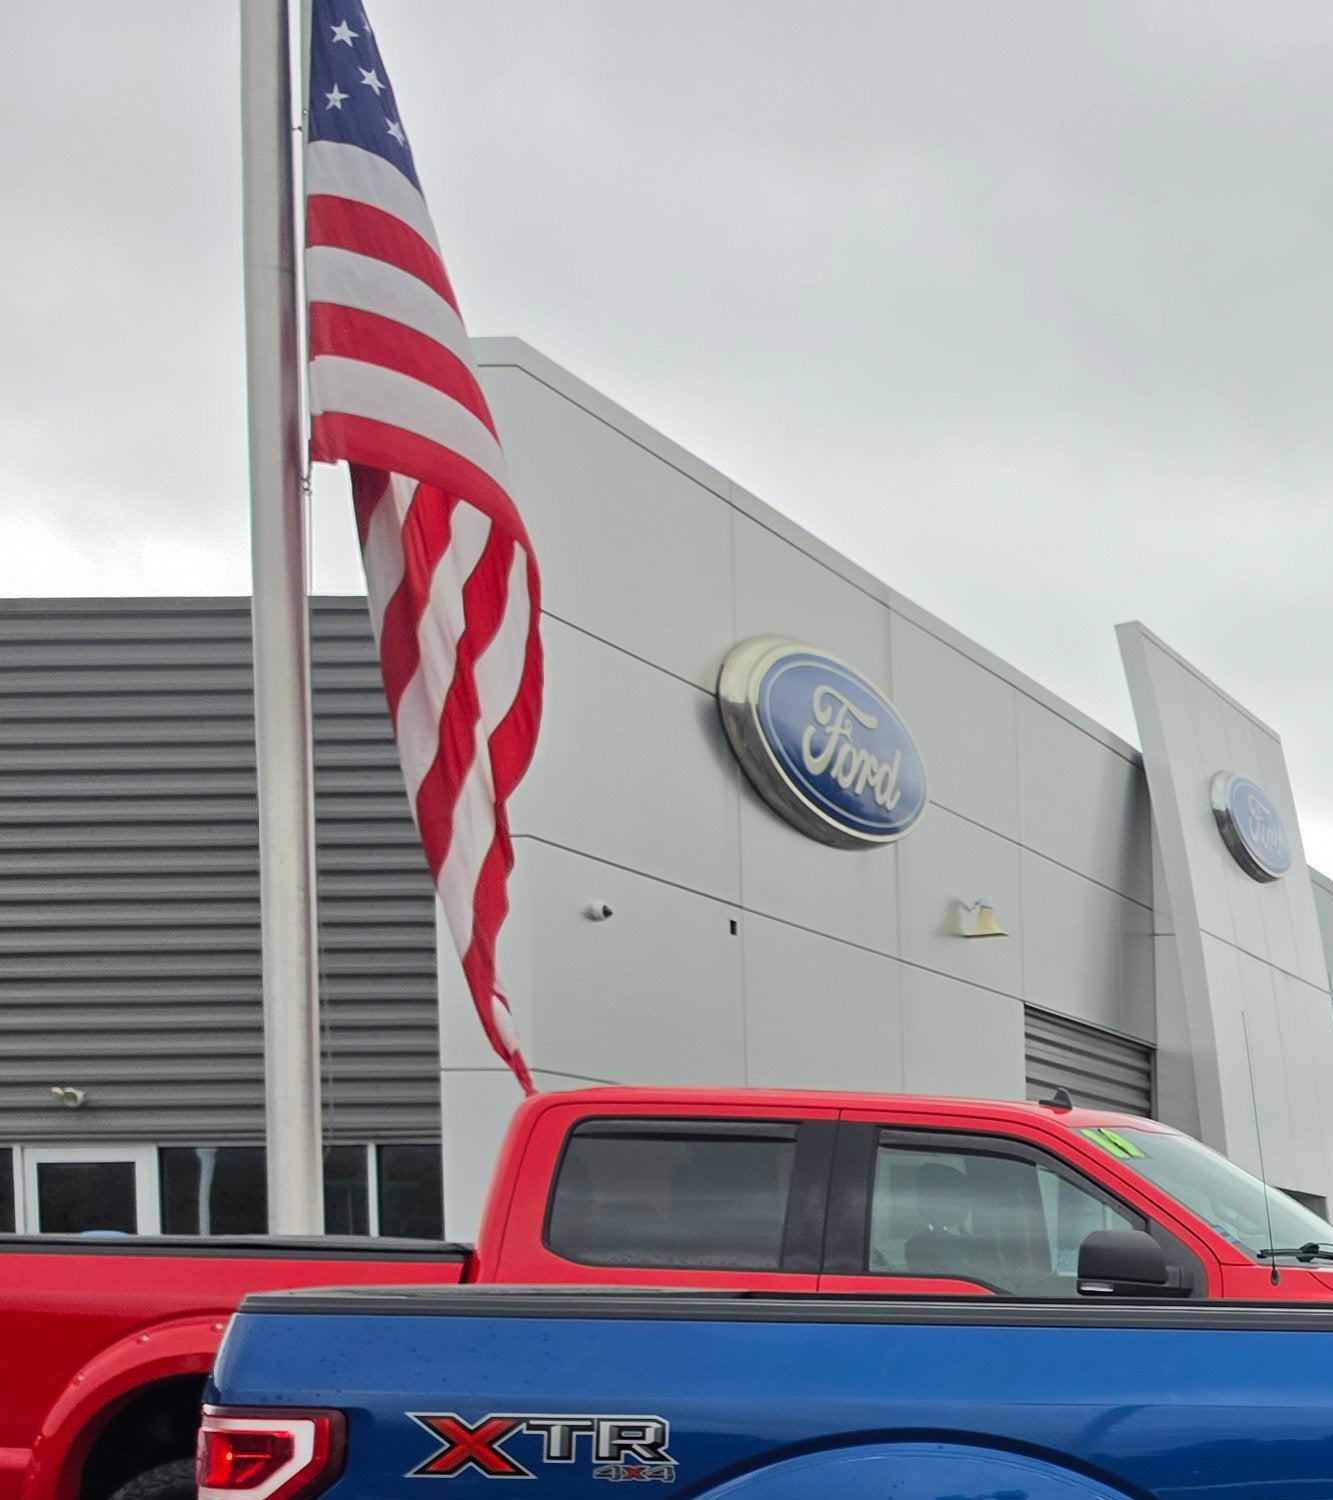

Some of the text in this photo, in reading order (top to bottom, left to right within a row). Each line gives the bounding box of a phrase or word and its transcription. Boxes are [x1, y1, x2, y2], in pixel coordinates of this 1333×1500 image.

[802, 684, 902, 811] Ford
[1247, 793, 1286, 860] Ford
[404, 1411, 680, 1480] XTR
